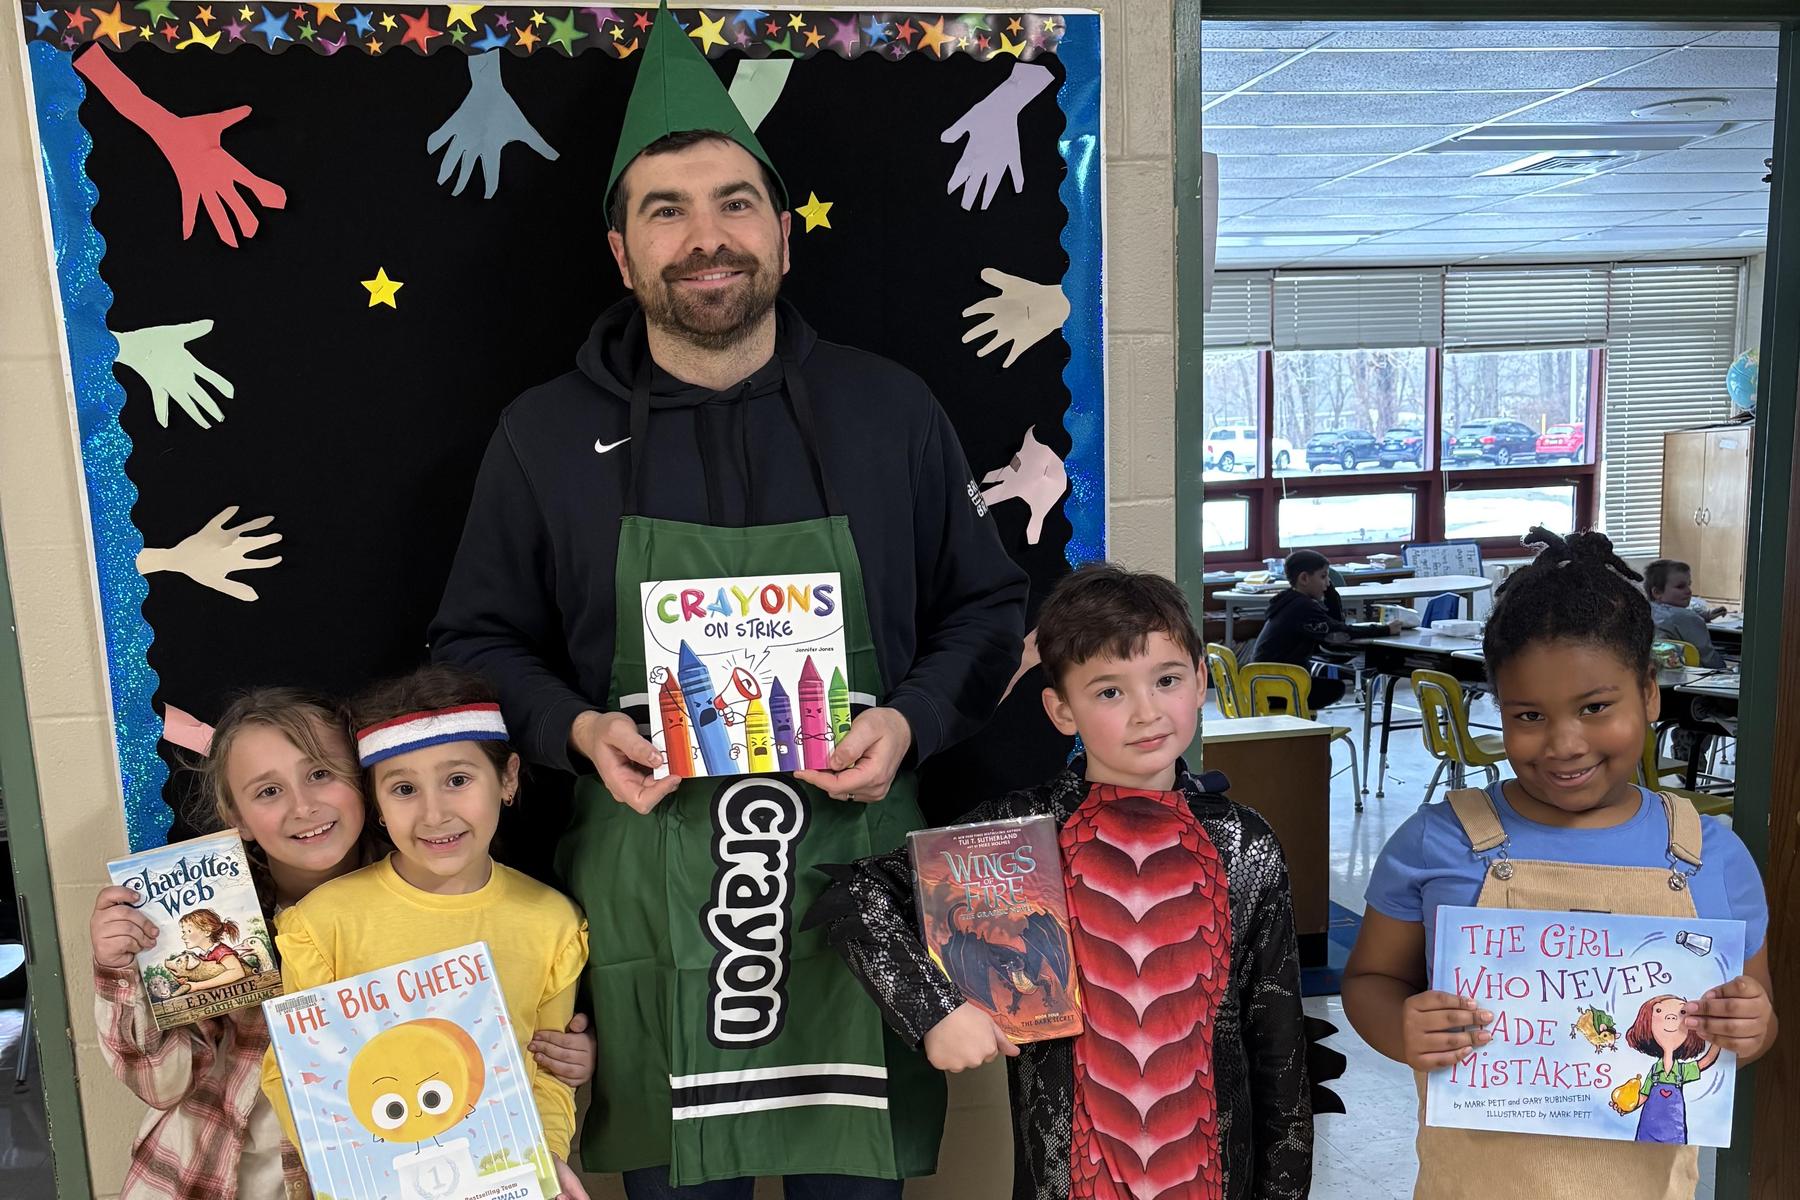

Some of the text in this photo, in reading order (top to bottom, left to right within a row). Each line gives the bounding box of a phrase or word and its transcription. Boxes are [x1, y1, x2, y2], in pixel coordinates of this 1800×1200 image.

[657, 583, 835, 624] CRAYONS
[704, 618, 793, 639] ON STRIKE
[978, 833, 1018, 844] SUTHERLAND
[122, 854, 239, 908] Charlotte's
[940, 846, 1037, 883] WINGS
[983, 877, 994, 885] OF
[156, 879, 214, 918] Web
[707, 778, 804, 1041] Crayon
[962, 876, 1027, 913] FIRE
[1461, 924, 1526, 960] THE
[208, 980, 258, 1005] WHITE
[337, 980, 390, 1019] BIG
[396, 954, 491, 1003] CHEESE
[1454, 961, 1673, 1002] WHO NEVER
[204, 1004, 234, 1015] GARTH
[236, 989, 275, 1005] WILLIAMS
[1489, 1011, 1558, 1046] ADE
[1464, 1100, 1486, 1108] MARK
[1488, 1099, 1506, 1107] PETT
[1508, 1098, 1521, 1106] and
[1522, 1097, 1543, 1105] GARY
[1544, 1094, 1591, 1104] RUBINSTEIN
[1486, 1110, 1536, 1118] ILLUSTRATED
[1538, 1111, 1547, 1119] by
[1573, 1111, 1592, 1119] PETT
